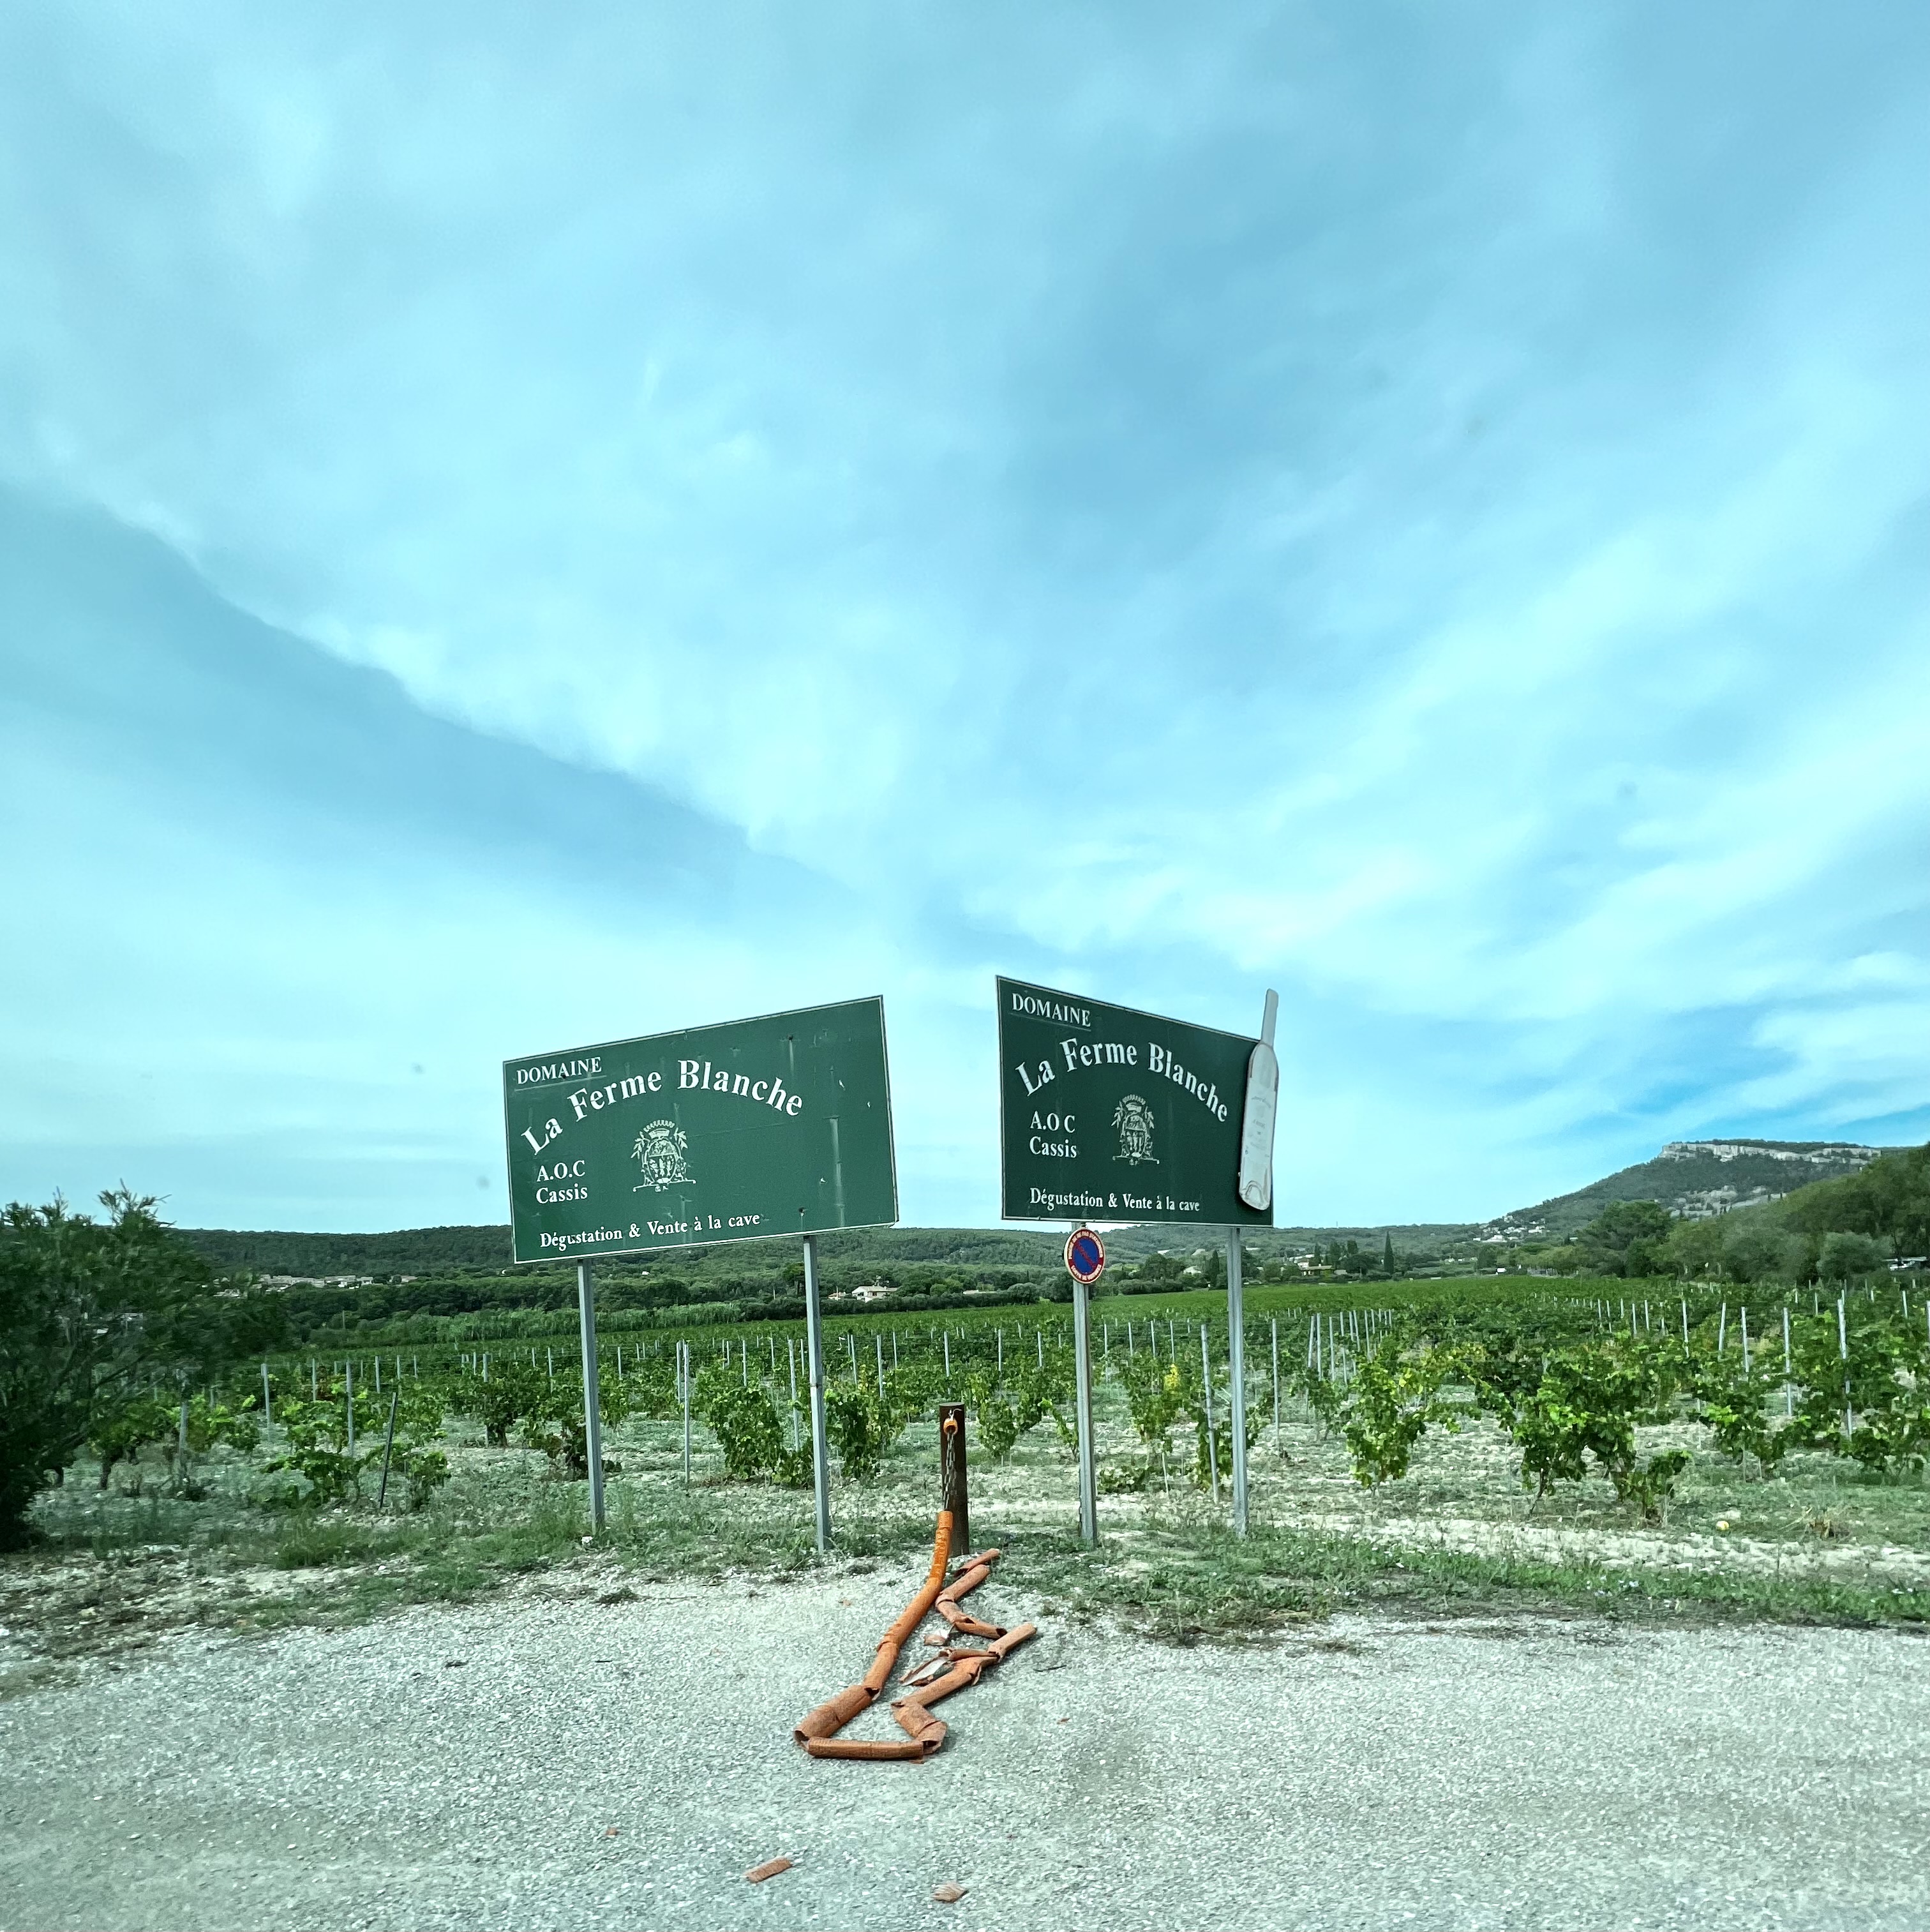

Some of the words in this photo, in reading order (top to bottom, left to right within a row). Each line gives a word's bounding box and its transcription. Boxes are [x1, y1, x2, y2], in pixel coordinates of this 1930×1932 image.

[1012, 992, 1091, 1027] DOMAINE
[516, 1056, 602, 1084] DOMAINE
[1015, 1060, 1056, 1097] La
[1059, 1038, 1137, 1072] Ferme
[1148, 1042, 1227, 1122] Blanche
[520, 1118, 564, 1156] La
[566, 1072, 662, 1122] Ferme
[677, 1060, 802, 1116] Blanche
[1029, 1135, 1077, 1158] Cassis
[536, 1160, 586, 1182] A.O.C
[535, 1183, 588, 1204] Cassis
[1029, 1187, 1103, 1211] Dégustation
[1108, 1192, 1118, 1208] &
[1122, 1193, 1153, 1209] Vente
[1156, 1195, 1162, 1209] à
[1165, 1195, 1176, 1210] la
[1179, 1201, 1200, 1211] cave
[539, 1226, 623, 1252] Dégustation
[629, 1223, 641, 1238] &
[646, 1220, 688, 1235] Vente
[694, 1216, 703, 1231] à
[707, 1215, 722, 1229] la
[728, 1215, 760, 1227] cave
